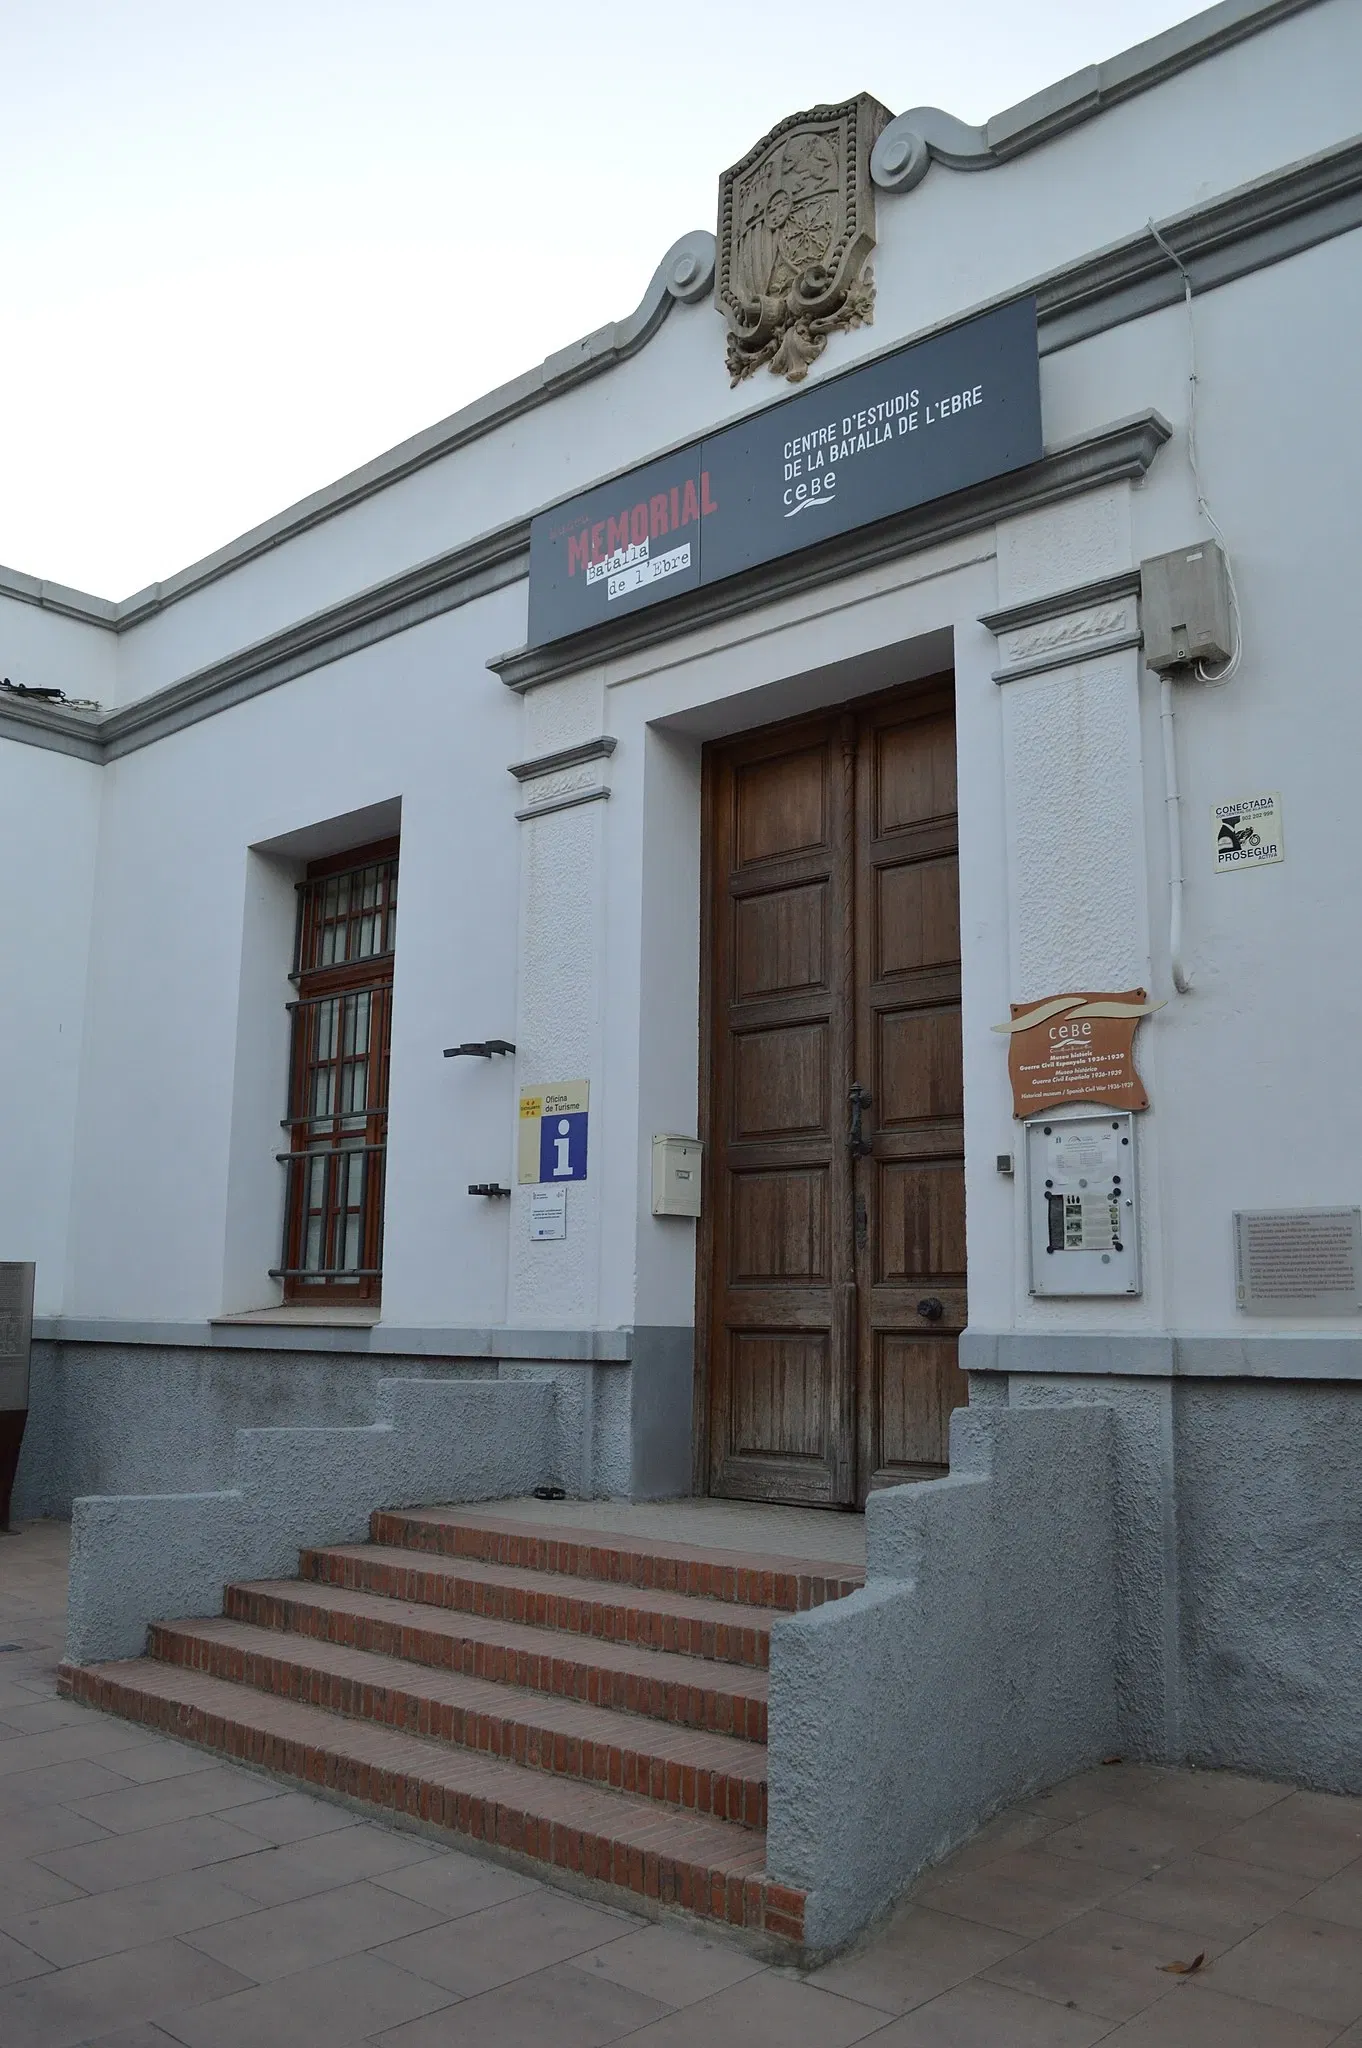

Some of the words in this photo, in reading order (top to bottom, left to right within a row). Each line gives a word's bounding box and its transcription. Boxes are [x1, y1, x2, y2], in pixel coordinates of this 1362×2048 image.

[784, 423, 837, 460] CENTRE
[842, 389, 920, 436] D'ESTUDIS
[784, 459, 802, 481] DE
[807, 450, 824, 472] LA
[830, 423, 893, 462] BATALLA
[899, 411, 918, 435] DE
[926, 385, 983, 424] L'EBRE
[568, 471, 718, 577] MEMORIAL
[588, 545, 648, 581] Batalla
[609, 581, 626, 596] de
[635, 552, 689, 585] l'Ebre
[1215, 797, 1274, 815] CONECTADA
[1218, 844, 1277, 863] PROSEGUR
[1041, 1061, 1055, 1069] Civil
[1056, 1058, 1086, 1067] Espanyola
[1088, 1053, 1125, 1062] 1936-1939
[1091, 1069, 1122, 1078] 1936-1939
[545, 1095, 568, 1104] Oficina
[555, 1103, 580, 1111] Turisme
